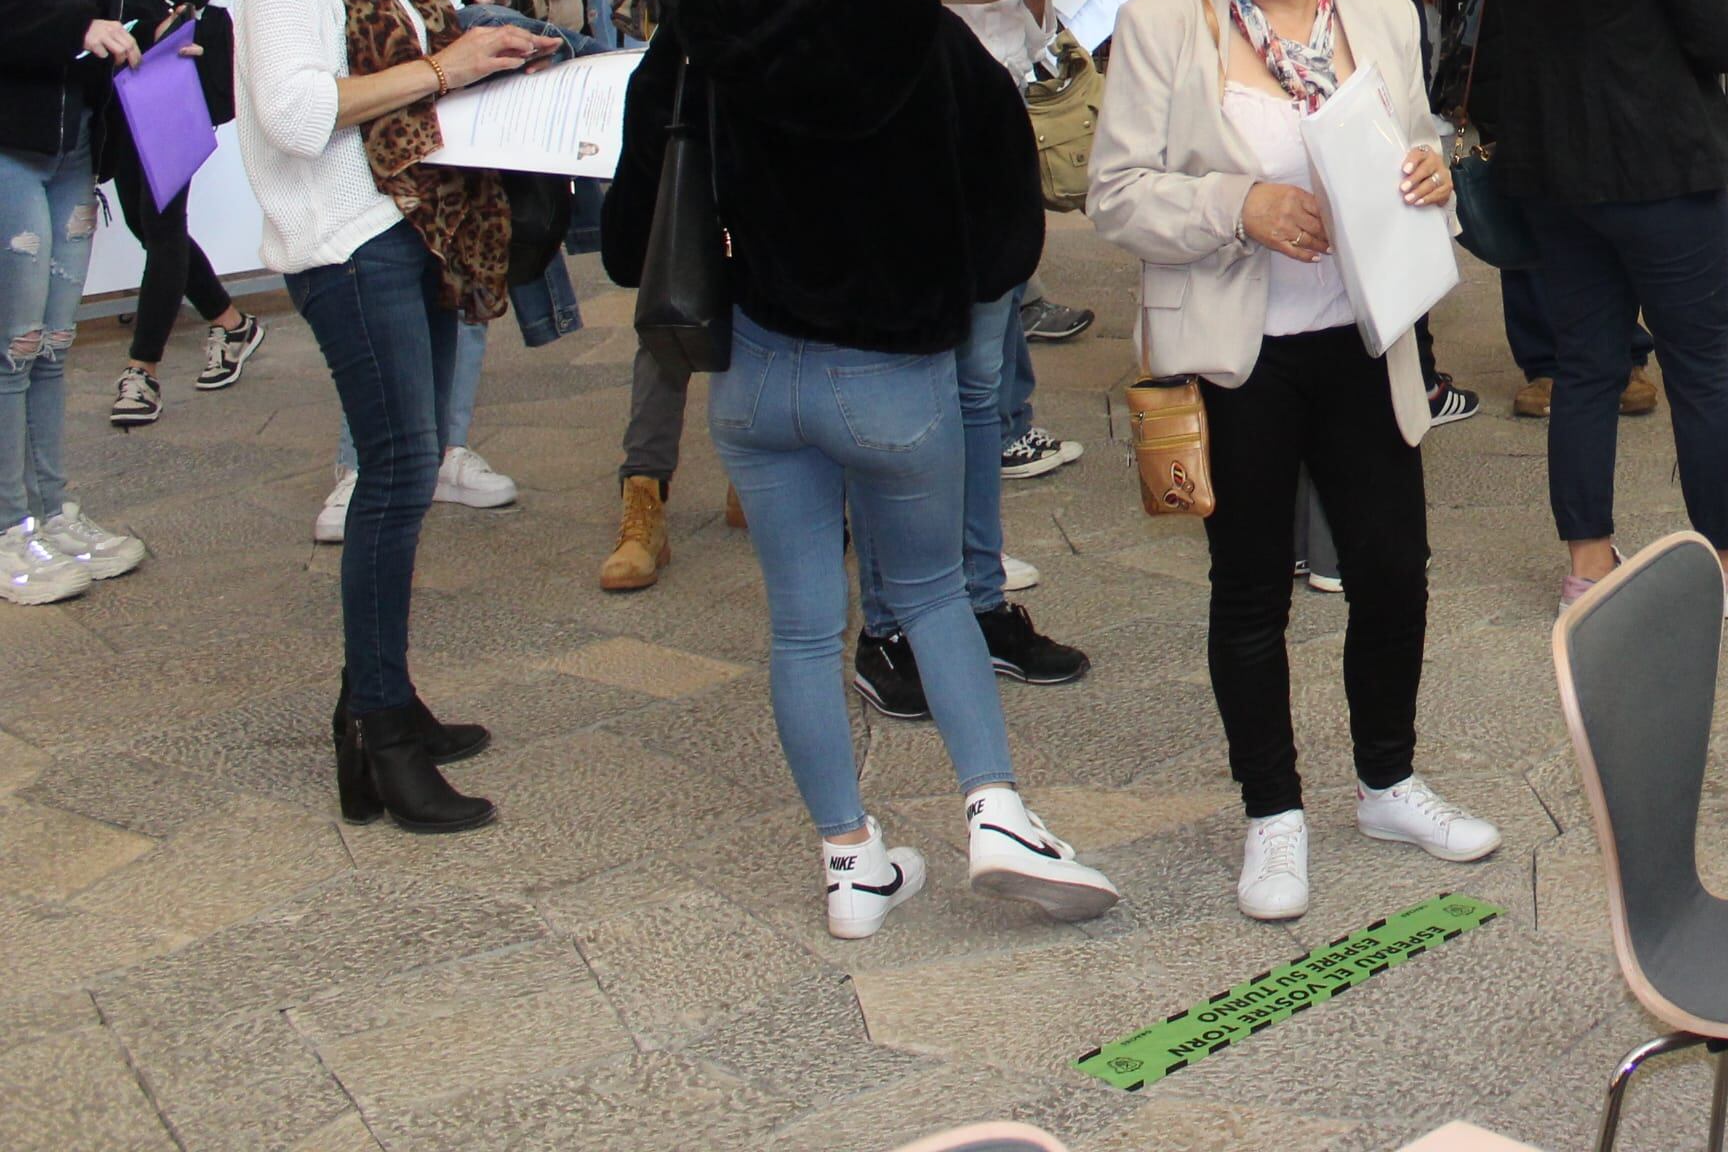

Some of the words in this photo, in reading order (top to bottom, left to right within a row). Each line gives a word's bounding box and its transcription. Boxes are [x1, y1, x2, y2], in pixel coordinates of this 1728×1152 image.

[829, 854, 859, 872] NIKE
[1305, 937, 1381, 973] ESPERE
[1354, 926, 1446, 968] ESPERAU
[1275, 970, 1309, 987] SU
[1323, 967, 1355, 982] EL
[1197, 985, 1279, 1023] TURNO
[1236, 982, 1328, 1024] VOSTRE
[1167, 1024, 1241, 1058] TORN
